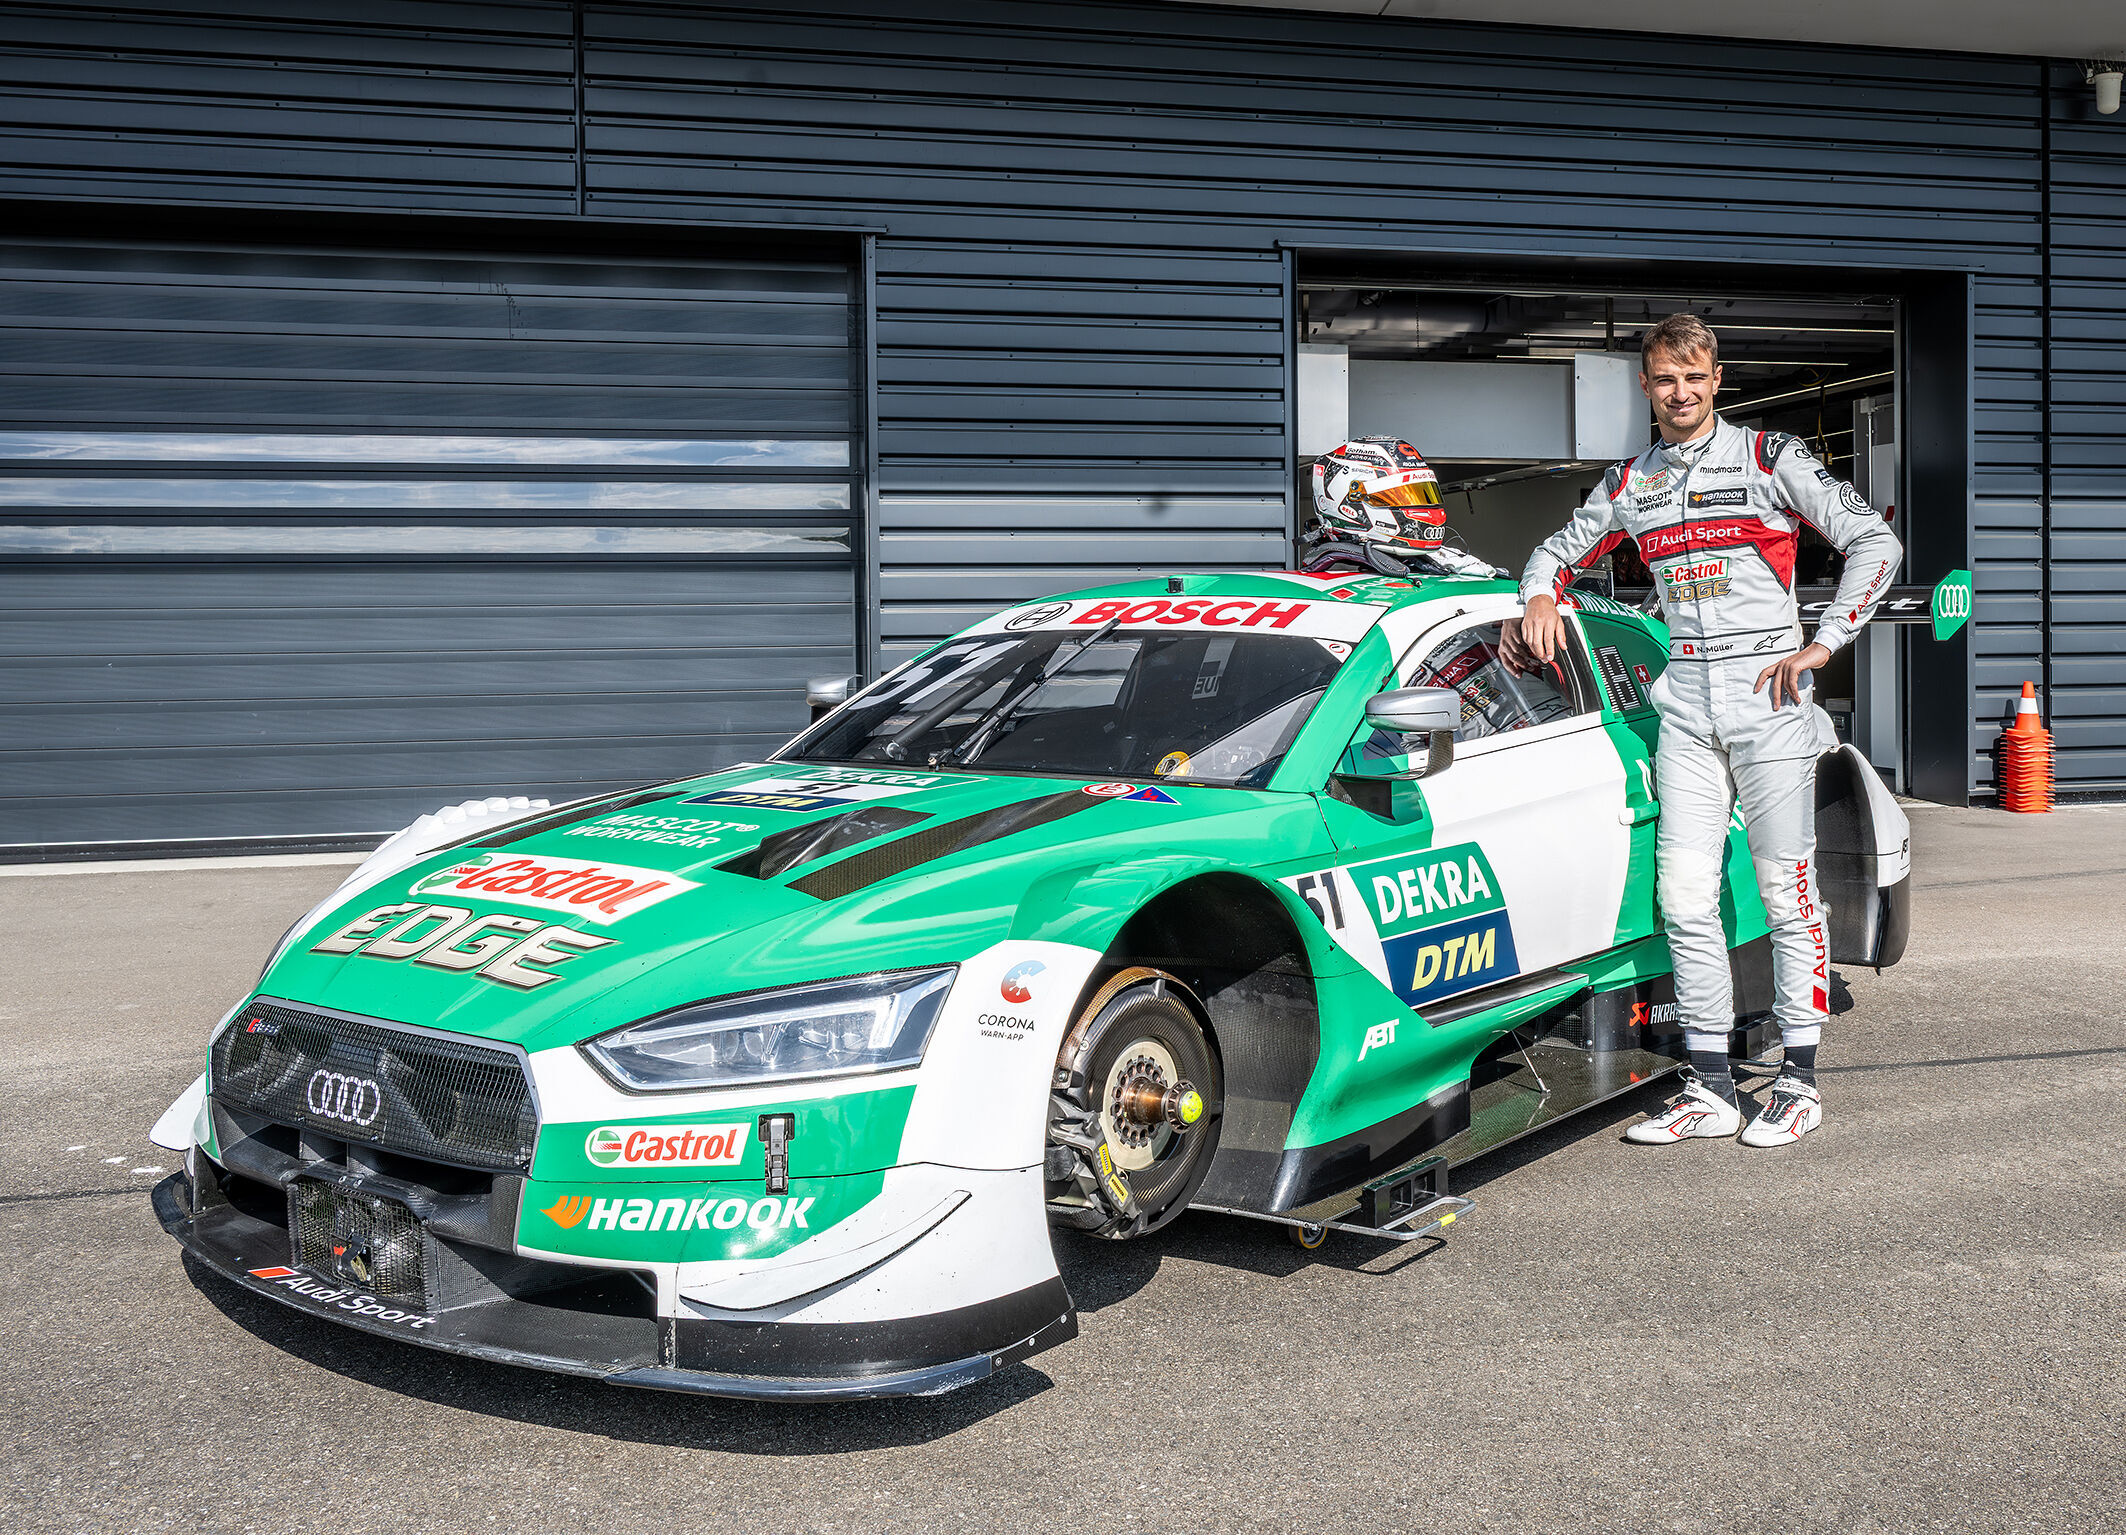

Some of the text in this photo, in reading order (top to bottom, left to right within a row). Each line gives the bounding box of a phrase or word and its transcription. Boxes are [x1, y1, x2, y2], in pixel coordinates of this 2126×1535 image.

[1700, 466, 1743, 475] mindmaze
[1638, 498, 1673, 514] WORKWEAR
[1660, 525, 1742, 547] Audi Sport
[1674, 559, 1725, 583] Castrol
[1667, 577, 1732, 603] EDGE
[1857, 559, 1889, 612] Audi Sport
[1069, 600, 1311, 629] BOSCH
[1697, 643, 1734, 654] N.Müller
[782, 782, 859, 796] 51
[802, 770, 943, 788] DEKRA
[709, 794, 823, 808] DTM
[563, 824, 721, 850] WORKWEAR
[455, 859, 671, 915] Castrol
[1371, 855, 1493, 925] DEKRA
[1296, 871, 1345, 930] 51
[1795, 859, 1828, 980] Audi Sport
[308, 901, 623, 992] EDGE
[1411, 928, 1496, 991] DTM
[978, 1013, 1036, 1032] CORONA
[980, 1029, 1025, 1042] WARN-APP
[1357, 1018, 1400, 1063] ABT
[623, 1128, 738, 1163] Castrol
[276, 1276, 437, 1329] Audi Sport
